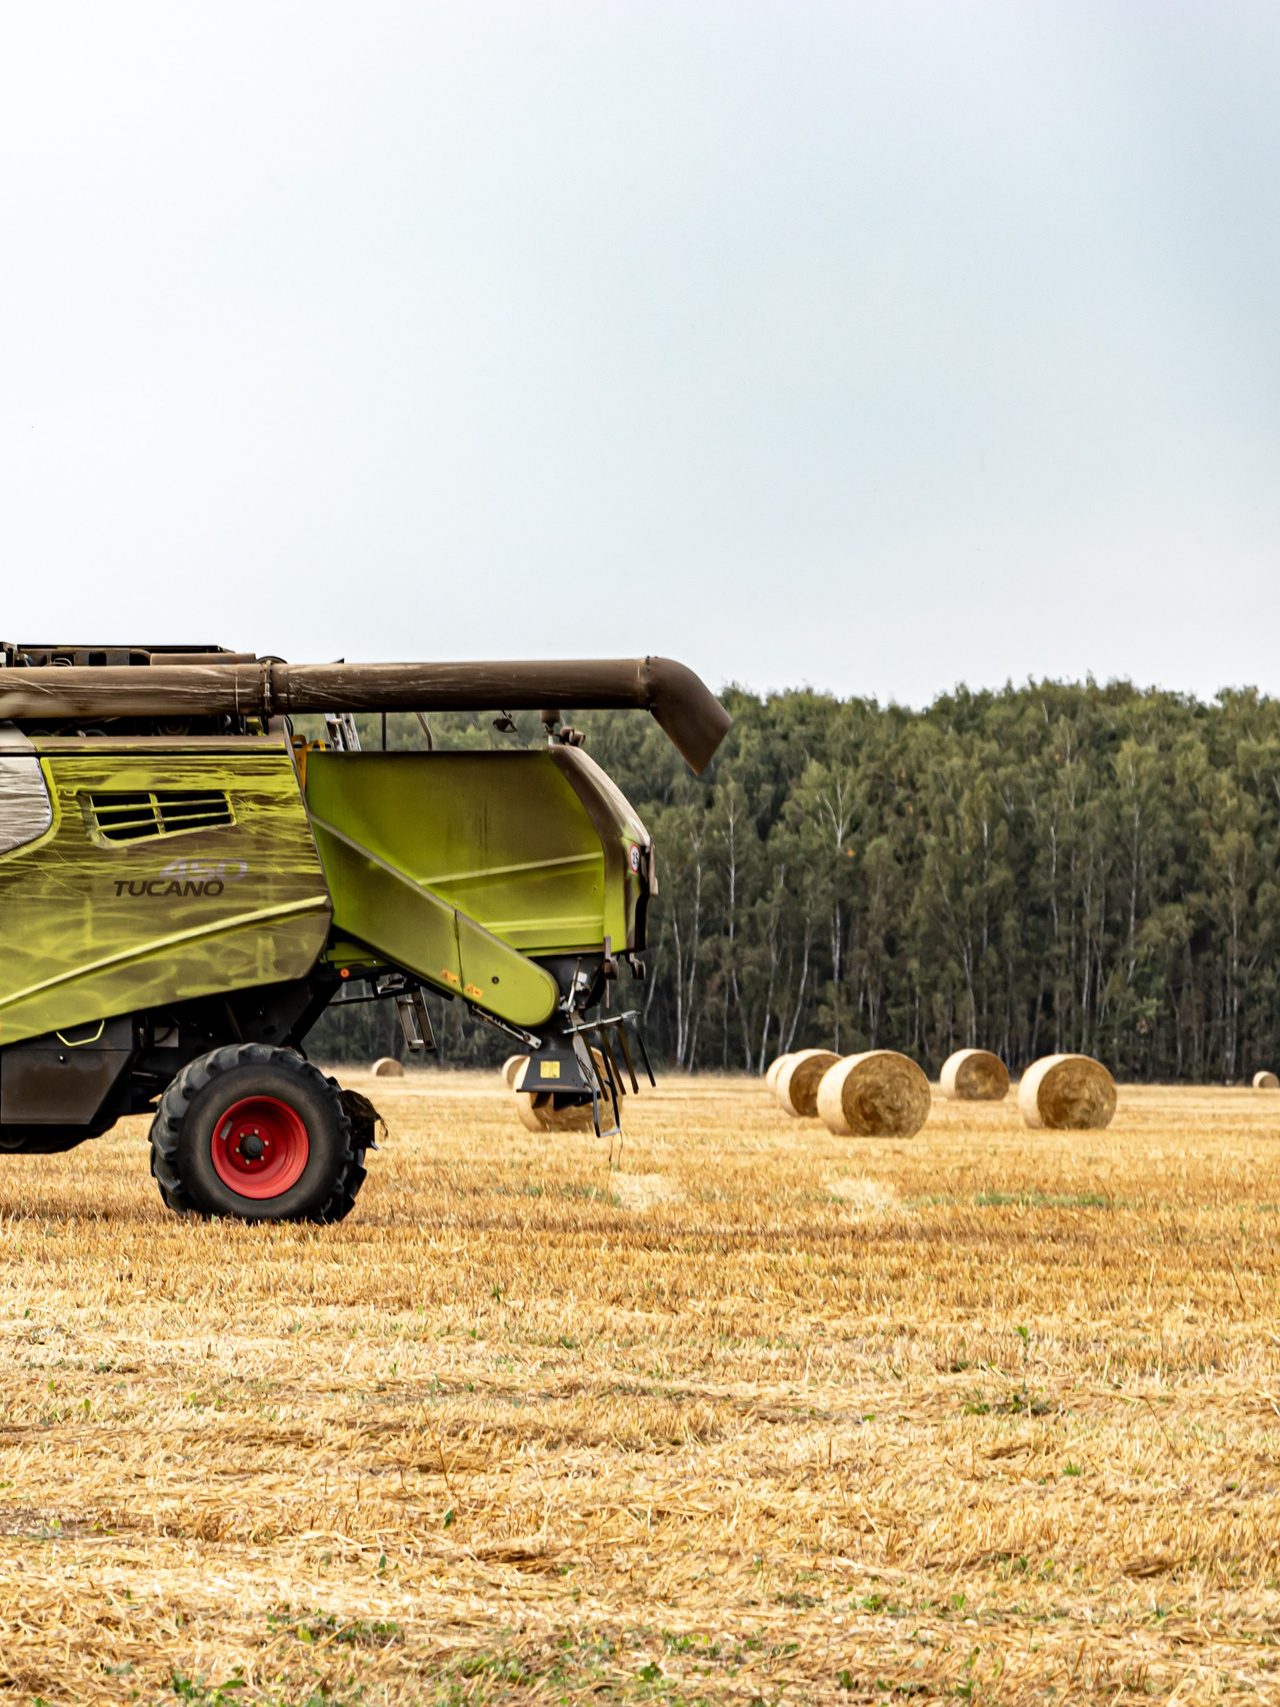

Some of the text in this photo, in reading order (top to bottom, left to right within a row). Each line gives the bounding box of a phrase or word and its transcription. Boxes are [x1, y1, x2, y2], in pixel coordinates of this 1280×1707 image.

[632, 852, 639, 866] 25
[158, 857, 249, 881] 450
[113, 880, 225, 897] TUCANO
